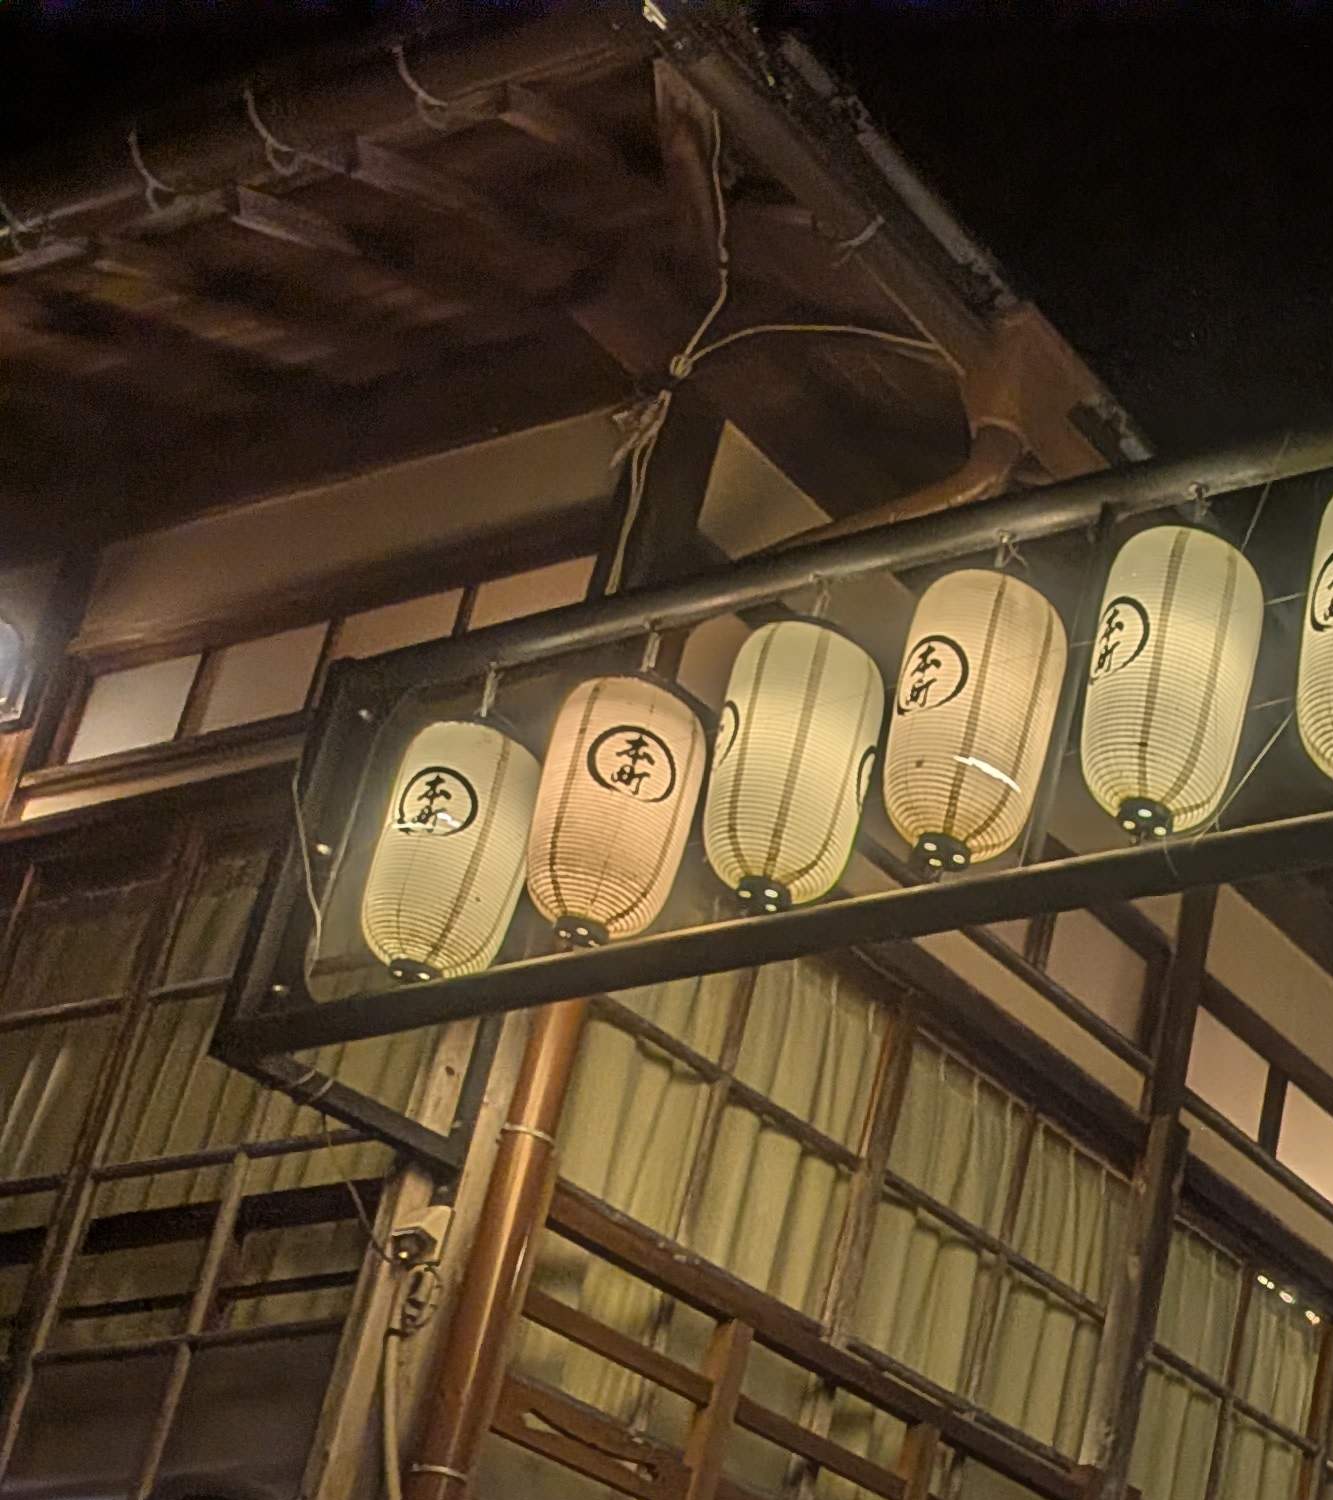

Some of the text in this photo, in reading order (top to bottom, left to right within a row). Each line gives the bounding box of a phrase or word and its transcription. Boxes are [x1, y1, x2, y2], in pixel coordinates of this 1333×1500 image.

[1095, 608, 1125, 674] 本町
[905, 644, 941, 711] 本町
[612, 737, 655, 795] 本町
[415, 775, 451, 829] 本町
